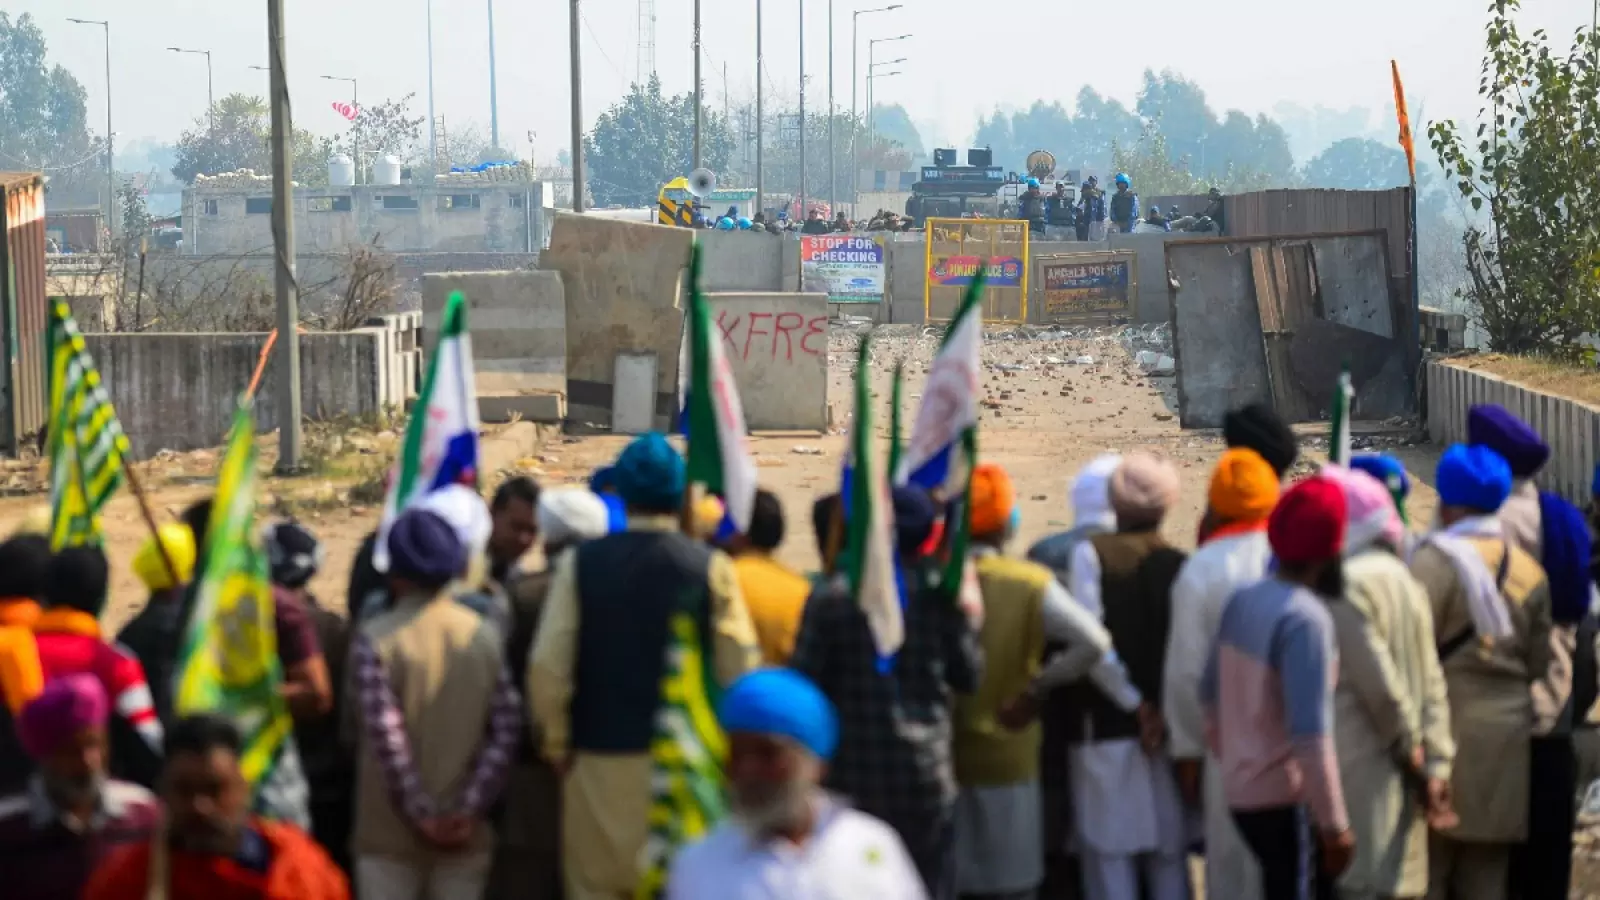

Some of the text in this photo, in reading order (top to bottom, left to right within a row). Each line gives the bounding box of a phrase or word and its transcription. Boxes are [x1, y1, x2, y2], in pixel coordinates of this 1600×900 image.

[810, 237, 873, 249] STOP FOR
[811, 251, 877, 262] CHECKING
[949, 263, 977, 277] PUNJAB
